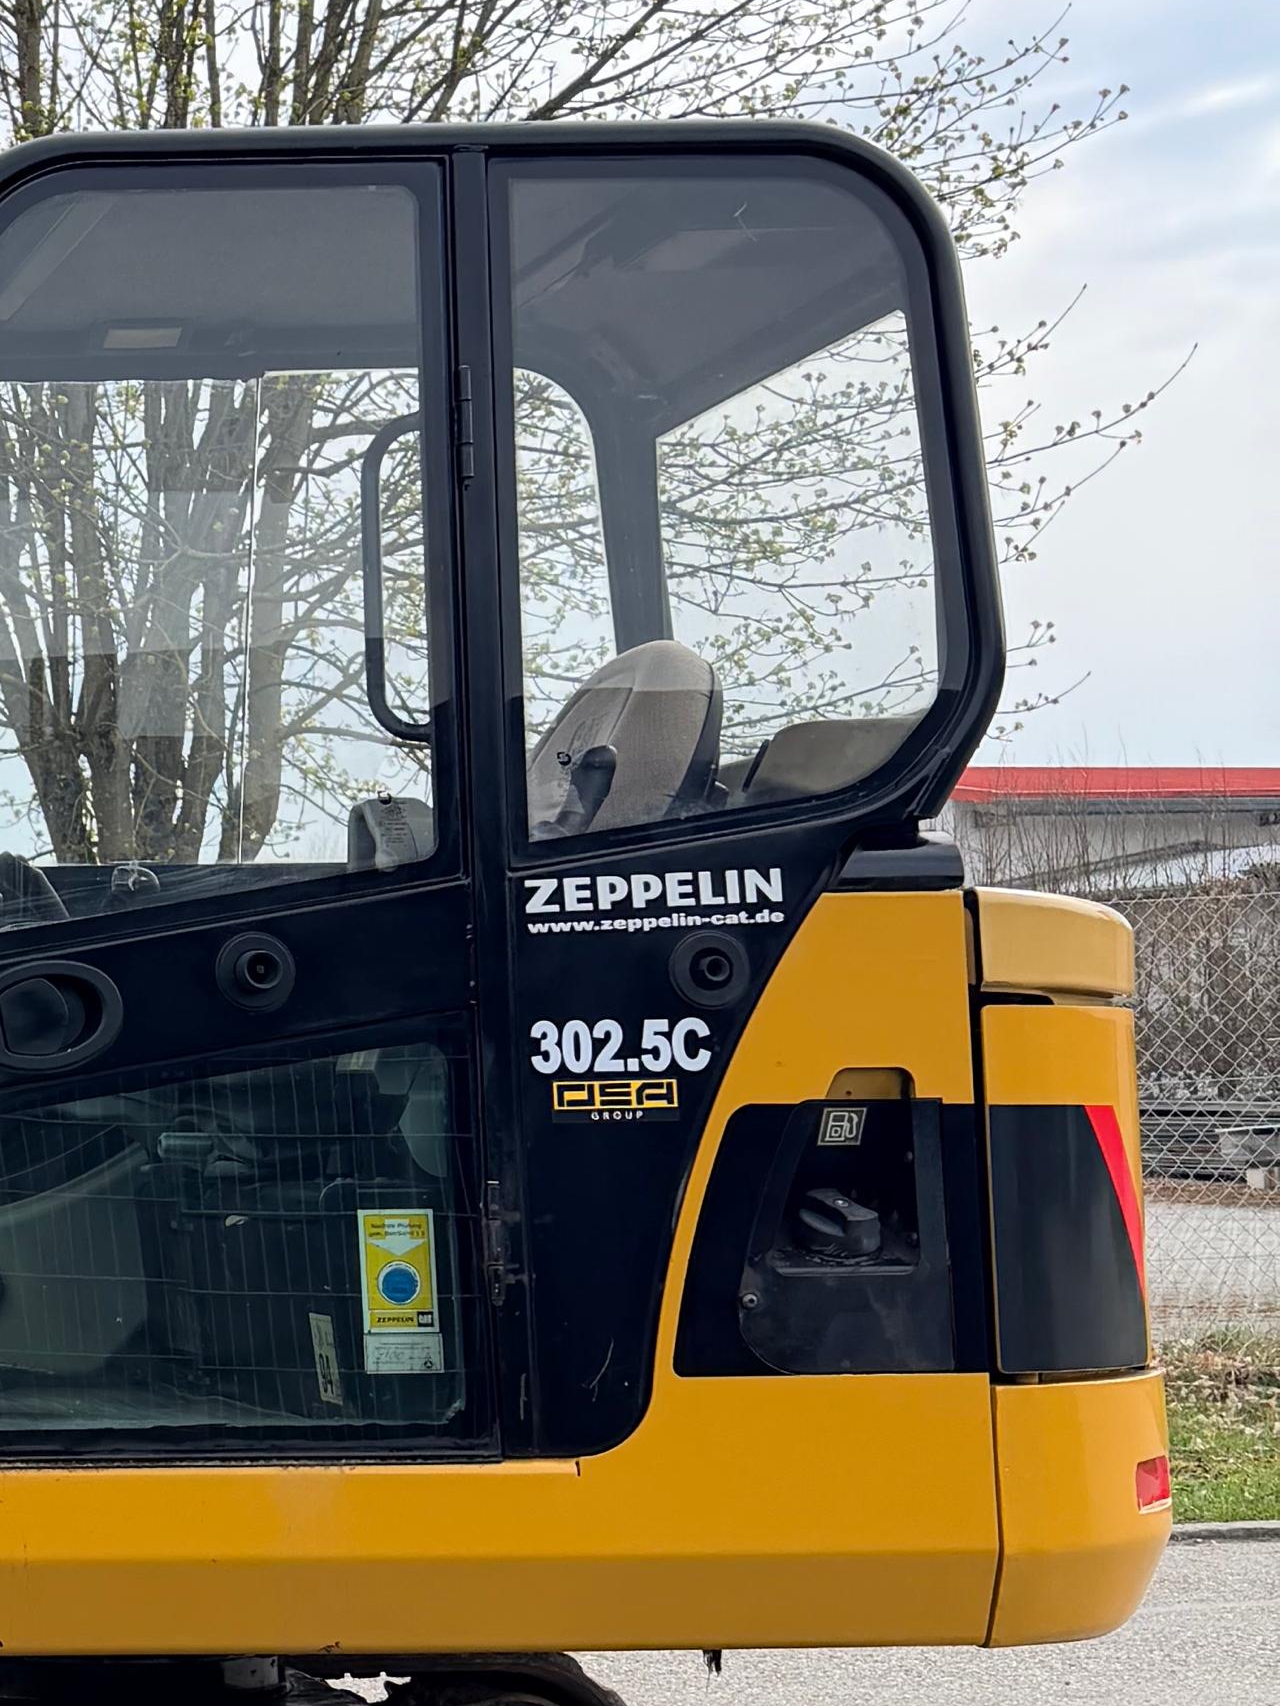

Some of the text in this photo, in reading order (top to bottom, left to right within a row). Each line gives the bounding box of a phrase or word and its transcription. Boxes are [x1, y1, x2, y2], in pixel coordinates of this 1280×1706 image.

[524, 868, 784, 914] ZEPPELIN
[527, 909, 785, 934] www.zeppelin-cat.de
[530, 1017, 712, 1074] 302.5C
[590, 1110, 644, 1121] GROUP
